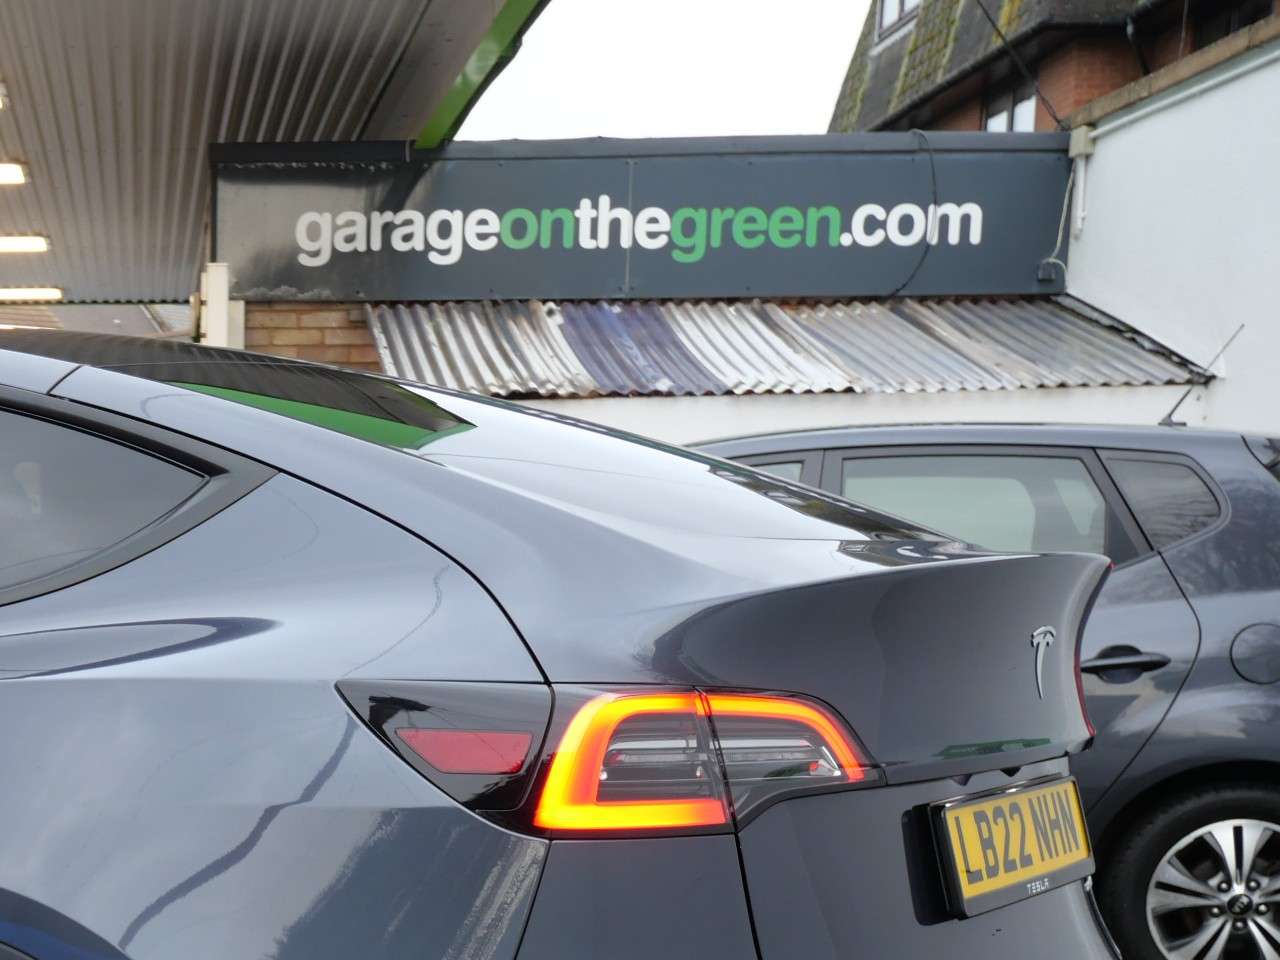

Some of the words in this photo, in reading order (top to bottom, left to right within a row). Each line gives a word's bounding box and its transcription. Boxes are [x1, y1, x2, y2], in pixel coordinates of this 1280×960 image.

[295, 194, 983, 267] garageonthegreen.com
[955, 803, 1033, 884] LB22
[1028, 790, 1080, 862] NHN
[1026, 877, 1049, 895] TESLA
